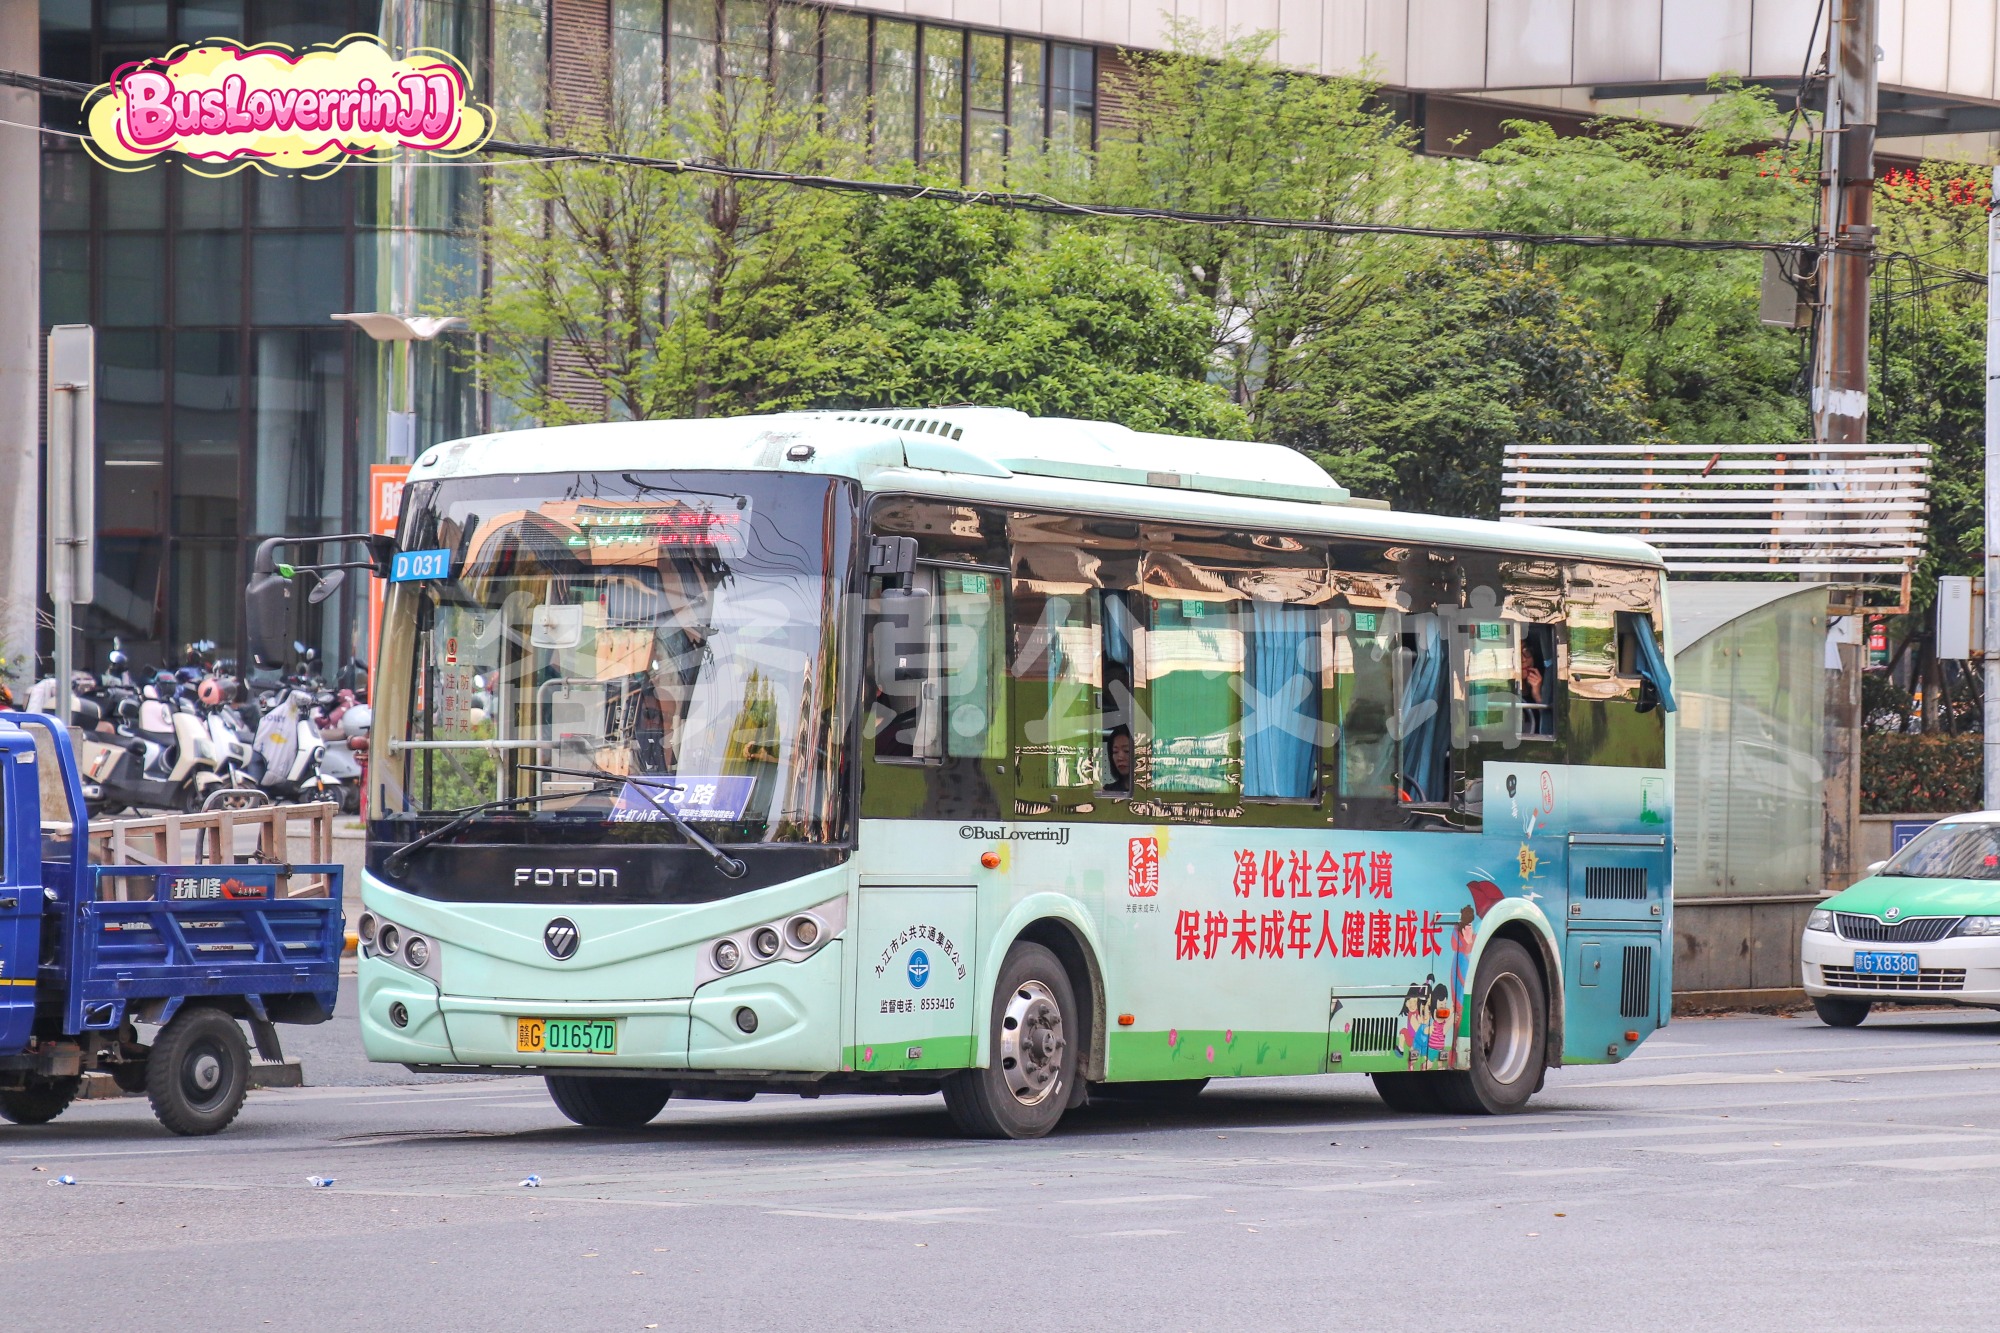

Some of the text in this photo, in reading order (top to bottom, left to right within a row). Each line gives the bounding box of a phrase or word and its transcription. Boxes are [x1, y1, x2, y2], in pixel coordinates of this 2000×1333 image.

[396, 555, 442, 577] D 031
[445, 673, 456, 755] 注意开
[653, 783, 717, 805] 28路
[514, 868, 618, 887] FOTON
[1233, 849, 1393, 899] 净化社会环境
[173, 878, 211, 899] 珠峰
[1126, 903, 1161, 914] 关爱未成年人
[1174, 909, 1443, 960] 保护未成年人健康成长
[874, 924, 967, 980] 九江市公共交通集团公司
[920, 998, 955, 1010] 8553416
